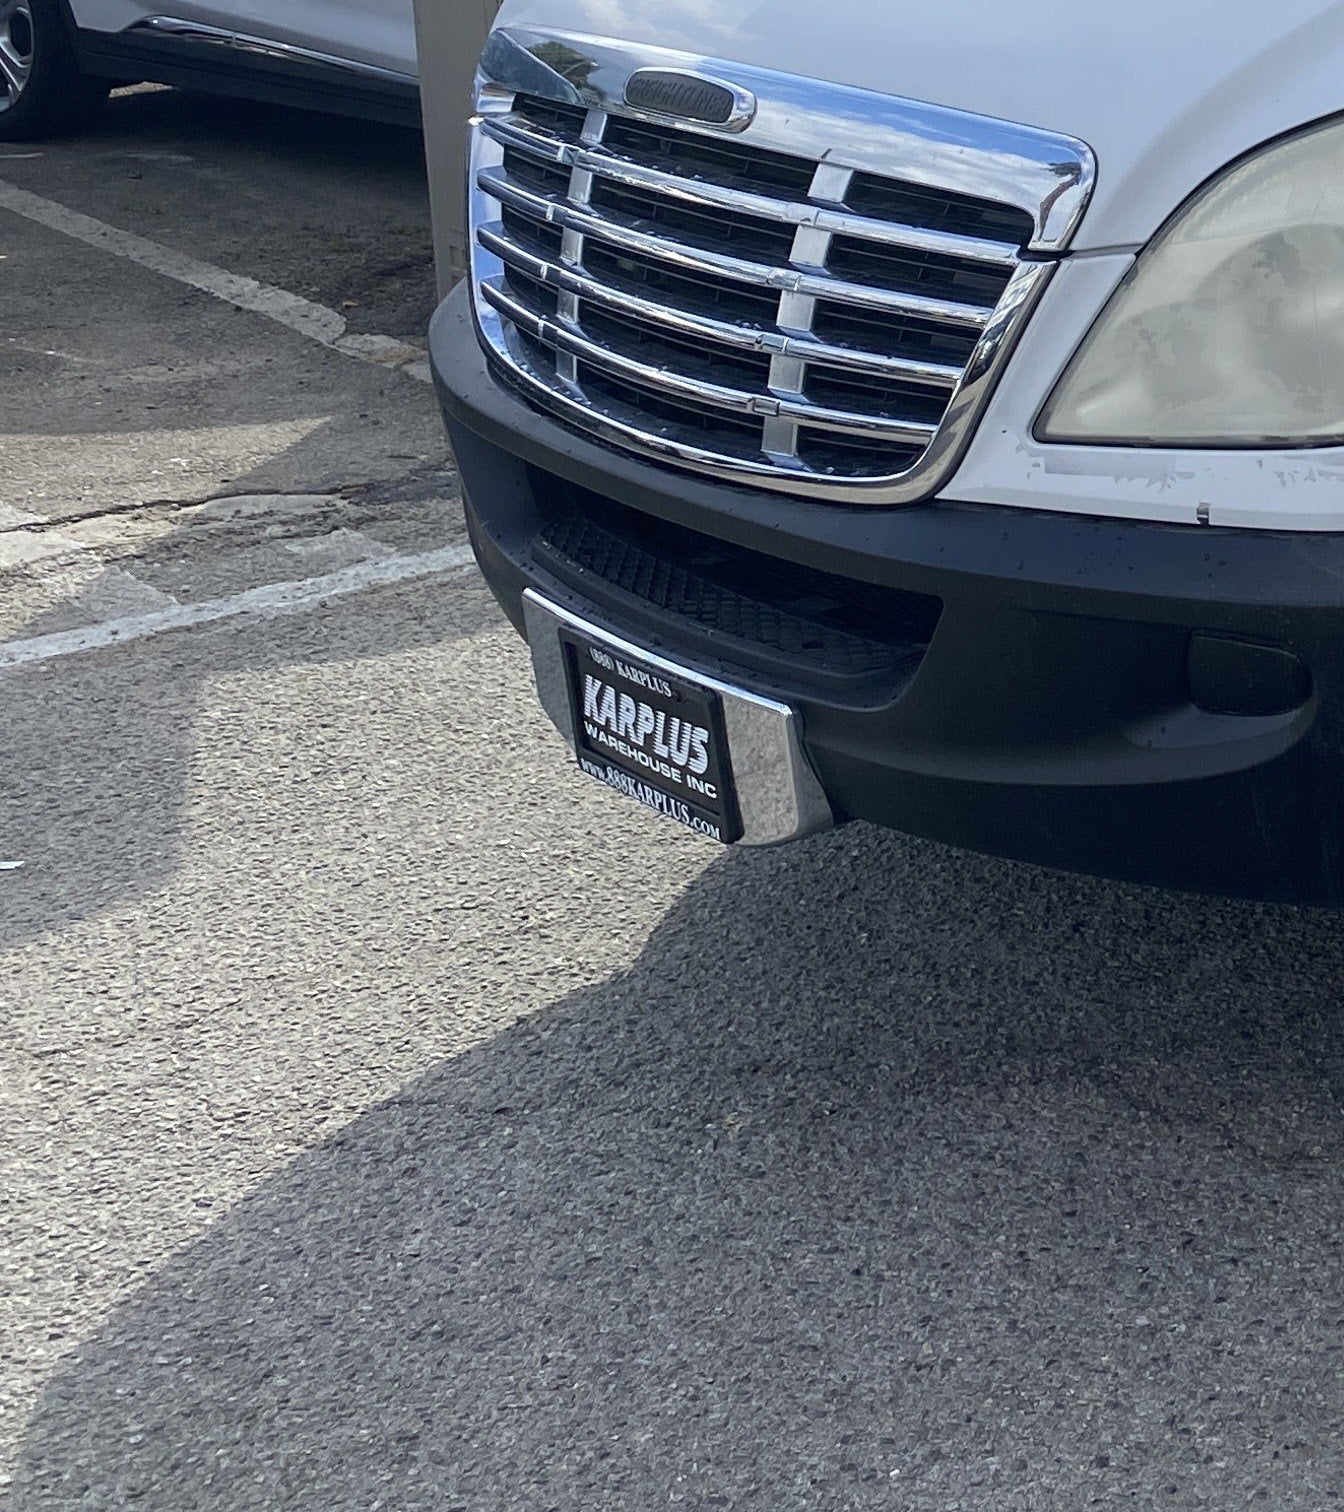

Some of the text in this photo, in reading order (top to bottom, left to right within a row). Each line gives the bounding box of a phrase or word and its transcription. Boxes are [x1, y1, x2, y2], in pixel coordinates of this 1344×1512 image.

[615, 659, 672, 698] KARPLUS
[583, 673, 709, 775] KARPLUS
[584, 720, 717, 799] WAREHOUSE INC
